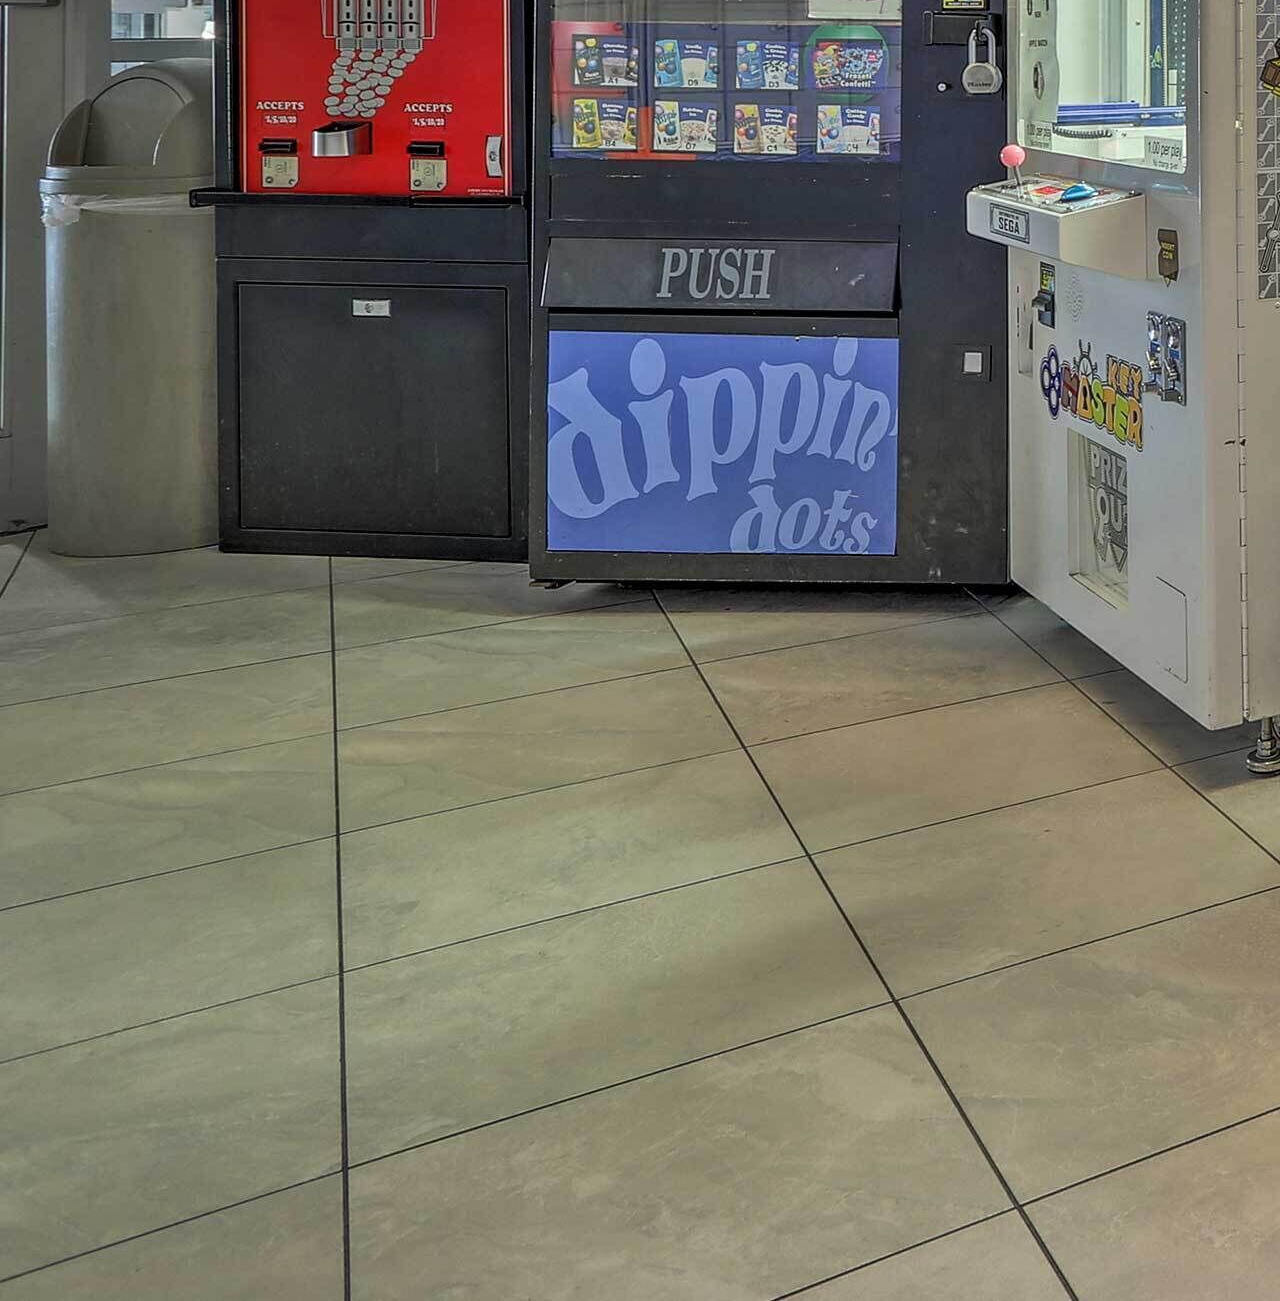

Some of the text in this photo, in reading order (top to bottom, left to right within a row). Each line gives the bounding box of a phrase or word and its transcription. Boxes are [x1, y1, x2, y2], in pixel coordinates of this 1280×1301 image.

[256, 101, 304, 111] ACCEPTS
[404, 103, 453, 114] ACCEPTS
[1148, 140, 1184, 161] 1.00 per play
[998, 216, 1020, 234] SEGA
[656, 247, 776, 299] PUSH
[1106, 354, 1143, 402] KEY
[1060, 360, 1143, 452] MASTER
[730, 483, 878, 554] dots
